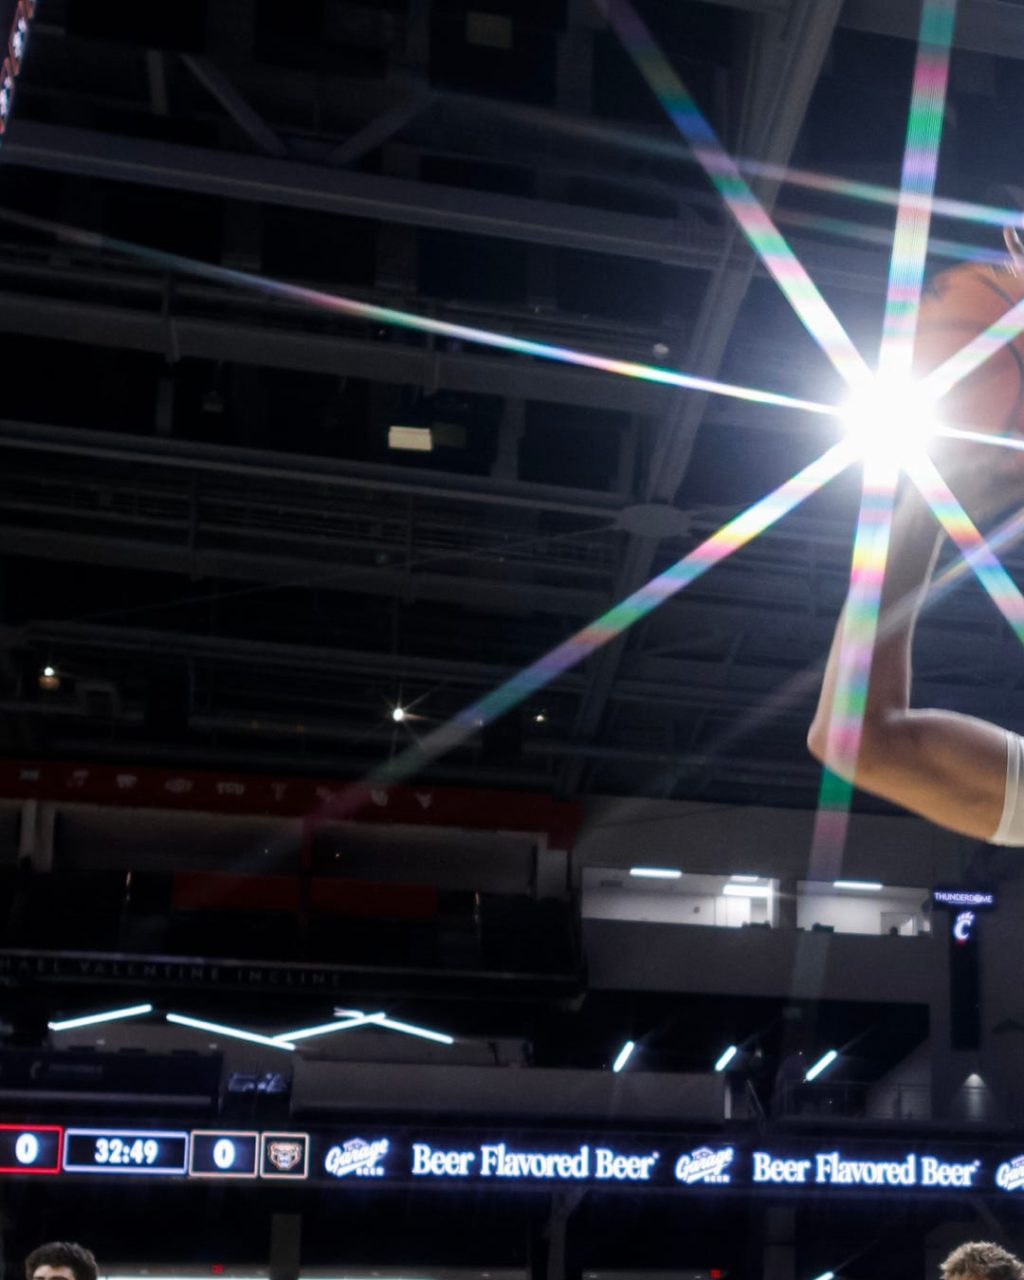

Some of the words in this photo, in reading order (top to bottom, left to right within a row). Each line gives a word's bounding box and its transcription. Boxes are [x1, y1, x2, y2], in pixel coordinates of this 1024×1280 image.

[933, 892, 994, 904] THUNDERDOME
[15, 1133, 38, 1164] 0
[94, 1138, 158, 1164] 32:49
[213, 1139, 235, 1169] 0
[325, 1139, 389, 1177] Garage
[412, 1144, 474, 1175] Beer
[480, 1143, 589, 1178] Flavored
[595, 1148, 655, 1179] Beer
[675, 1147, 733, 1184] Garage
[753, 1152, 811, 1182] Beer
[815, 1152, 915, 1185] Flavored
[920, 1157, 976, 1187] Beer
